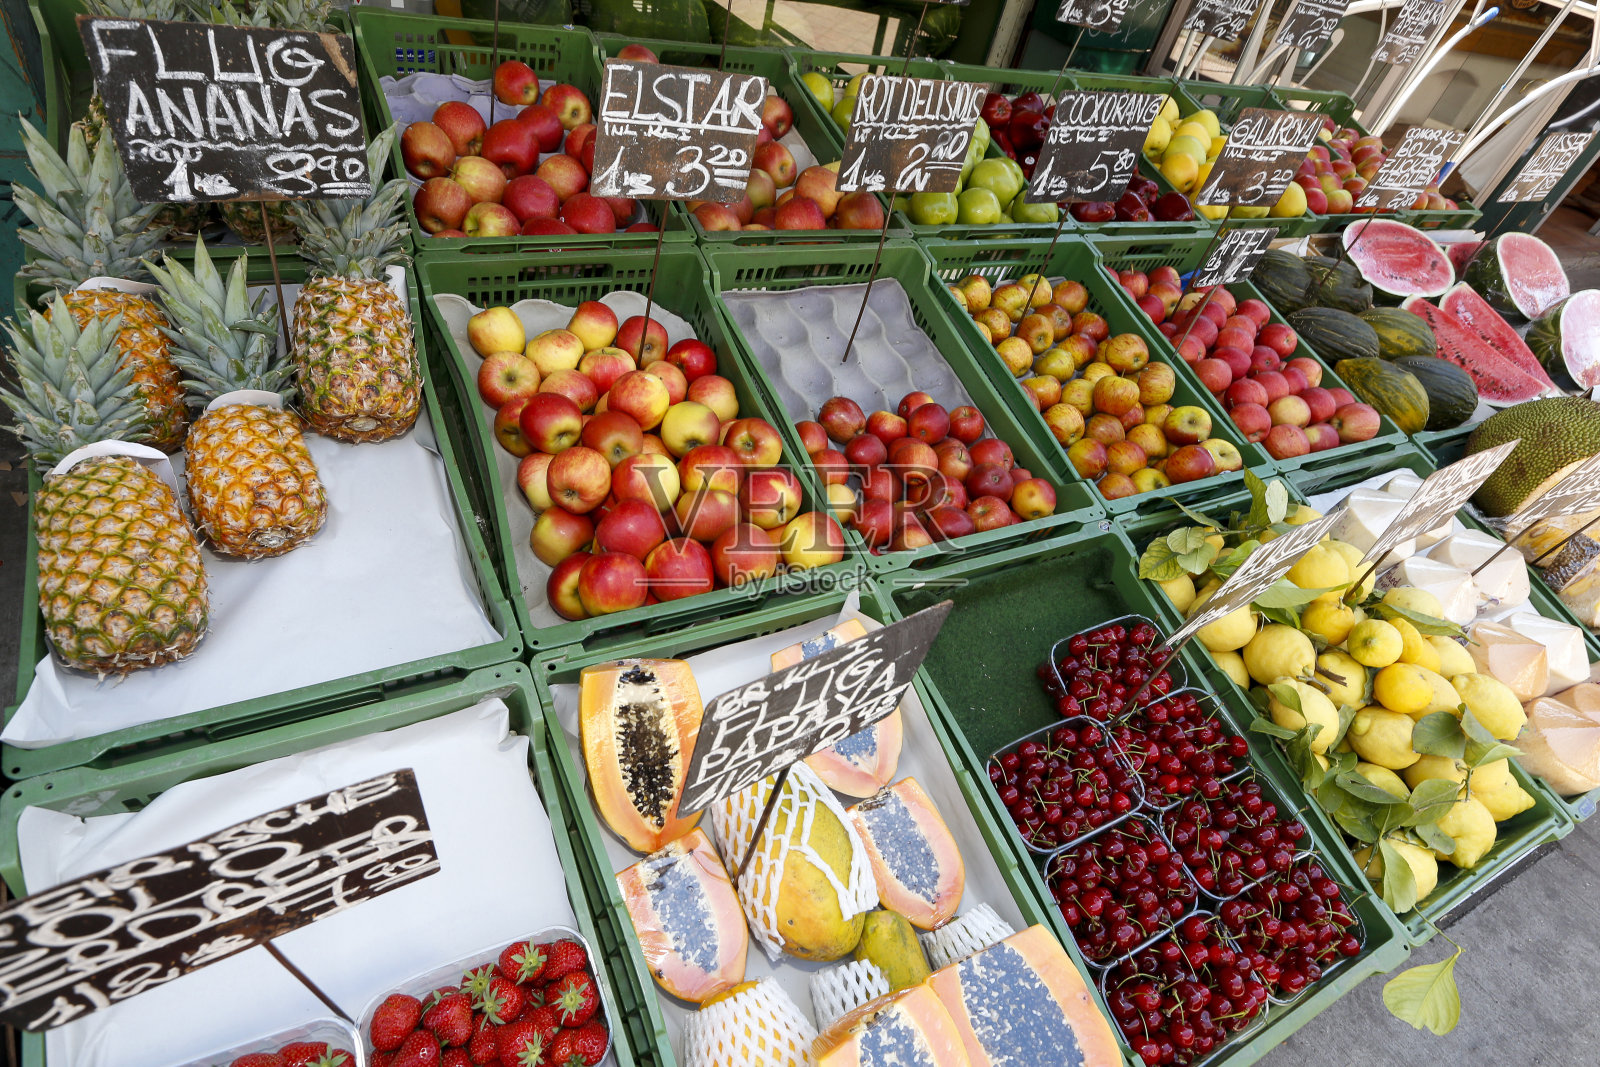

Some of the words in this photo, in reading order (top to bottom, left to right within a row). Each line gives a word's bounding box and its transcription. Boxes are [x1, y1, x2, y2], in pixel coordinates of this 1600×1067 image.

[125, 78, 361, 141] ANANAS
[602, 64, 765, 127] ELSTAR
[854, 75, 903, 123] ROT
[1378, 155, 1443, 175] ZUCKER
[1520, 152, 1582, 175] MELONEN
[1540, 132, 1593, 154] WASSER
[593, 146, 626, 195] 1
[840, 147, 866, 192] 1
[1033, 156, 1055, 197] 1
[1213, 228, 1270, 257] APFEL
[695, 661, 896, 785] PAPAYA
